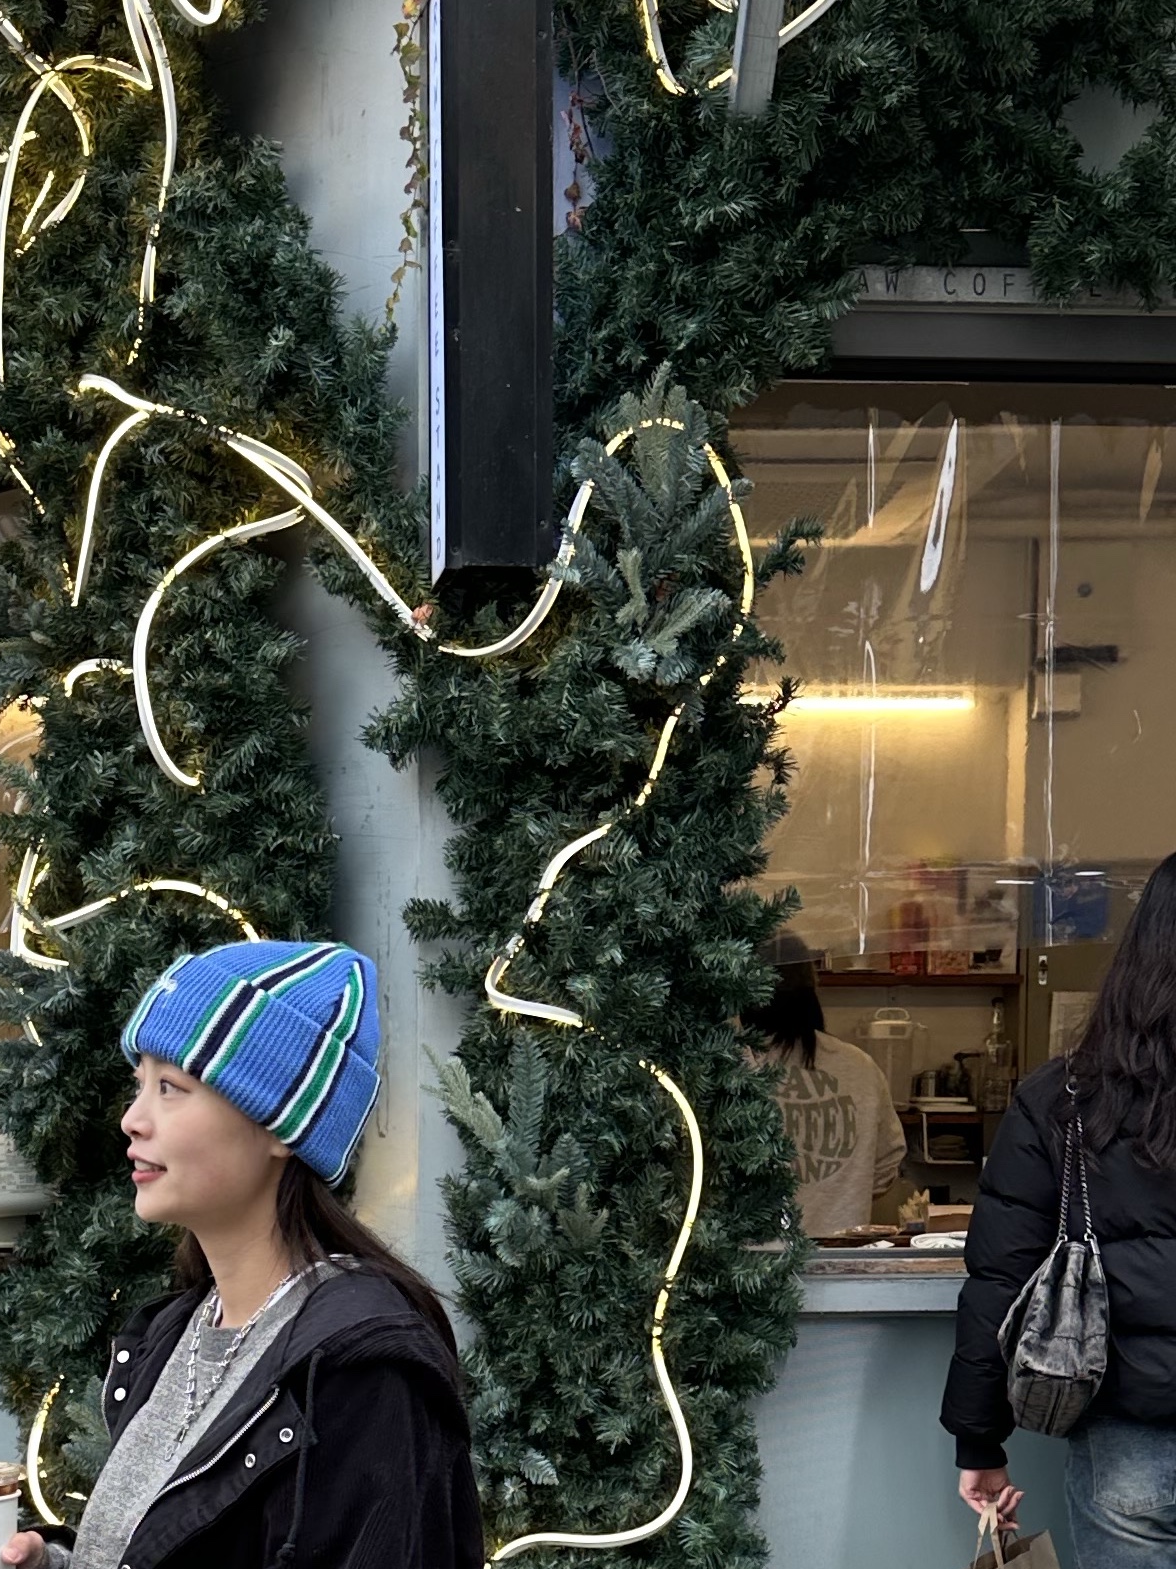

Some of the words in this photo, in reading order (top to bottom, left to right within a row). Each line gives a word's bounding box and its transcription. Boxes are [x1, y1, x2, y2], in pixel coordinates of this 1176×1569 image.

[858, 268, 900, 295] AW
[434, 386, 443, 561] STAND
[777, 1065, 839, 1100] AW
[784, 1095, 858, 1158] FFEE
